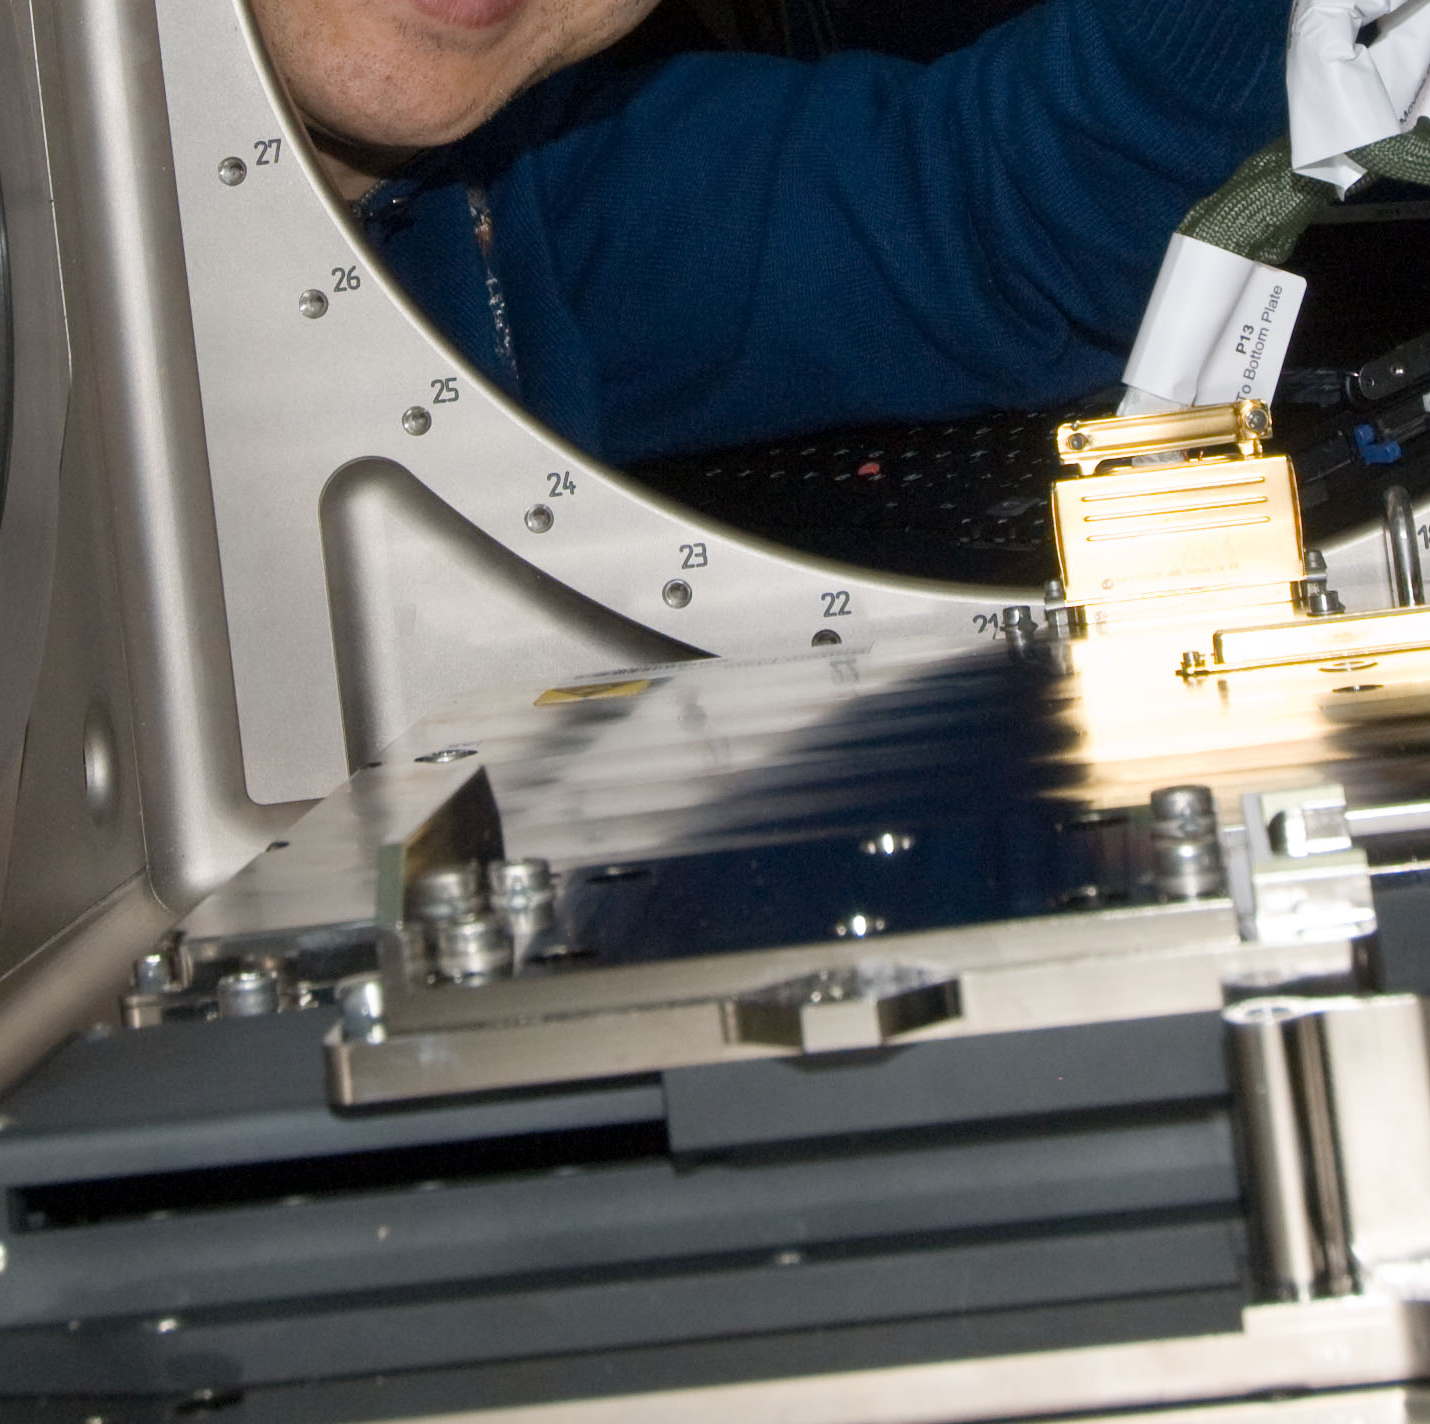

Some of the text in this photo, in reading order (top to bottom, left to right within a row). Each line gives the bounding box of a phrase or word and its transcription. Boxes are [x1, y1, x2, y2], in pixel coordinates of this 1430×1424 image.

[253, 138, 282, 166] 27
[331, 265, 361, 293] 26
[1235, 324, 1255, 355] P13
[1235, 284, 1283, 402] To Bottom Plate
[430, 377, 460, 405] 25
[546, 470, 577, 498] 24
[679, 542, 708, 570] 23
[820, 590, 852, 618] 22
[972, 613, 1000, 638] 21
